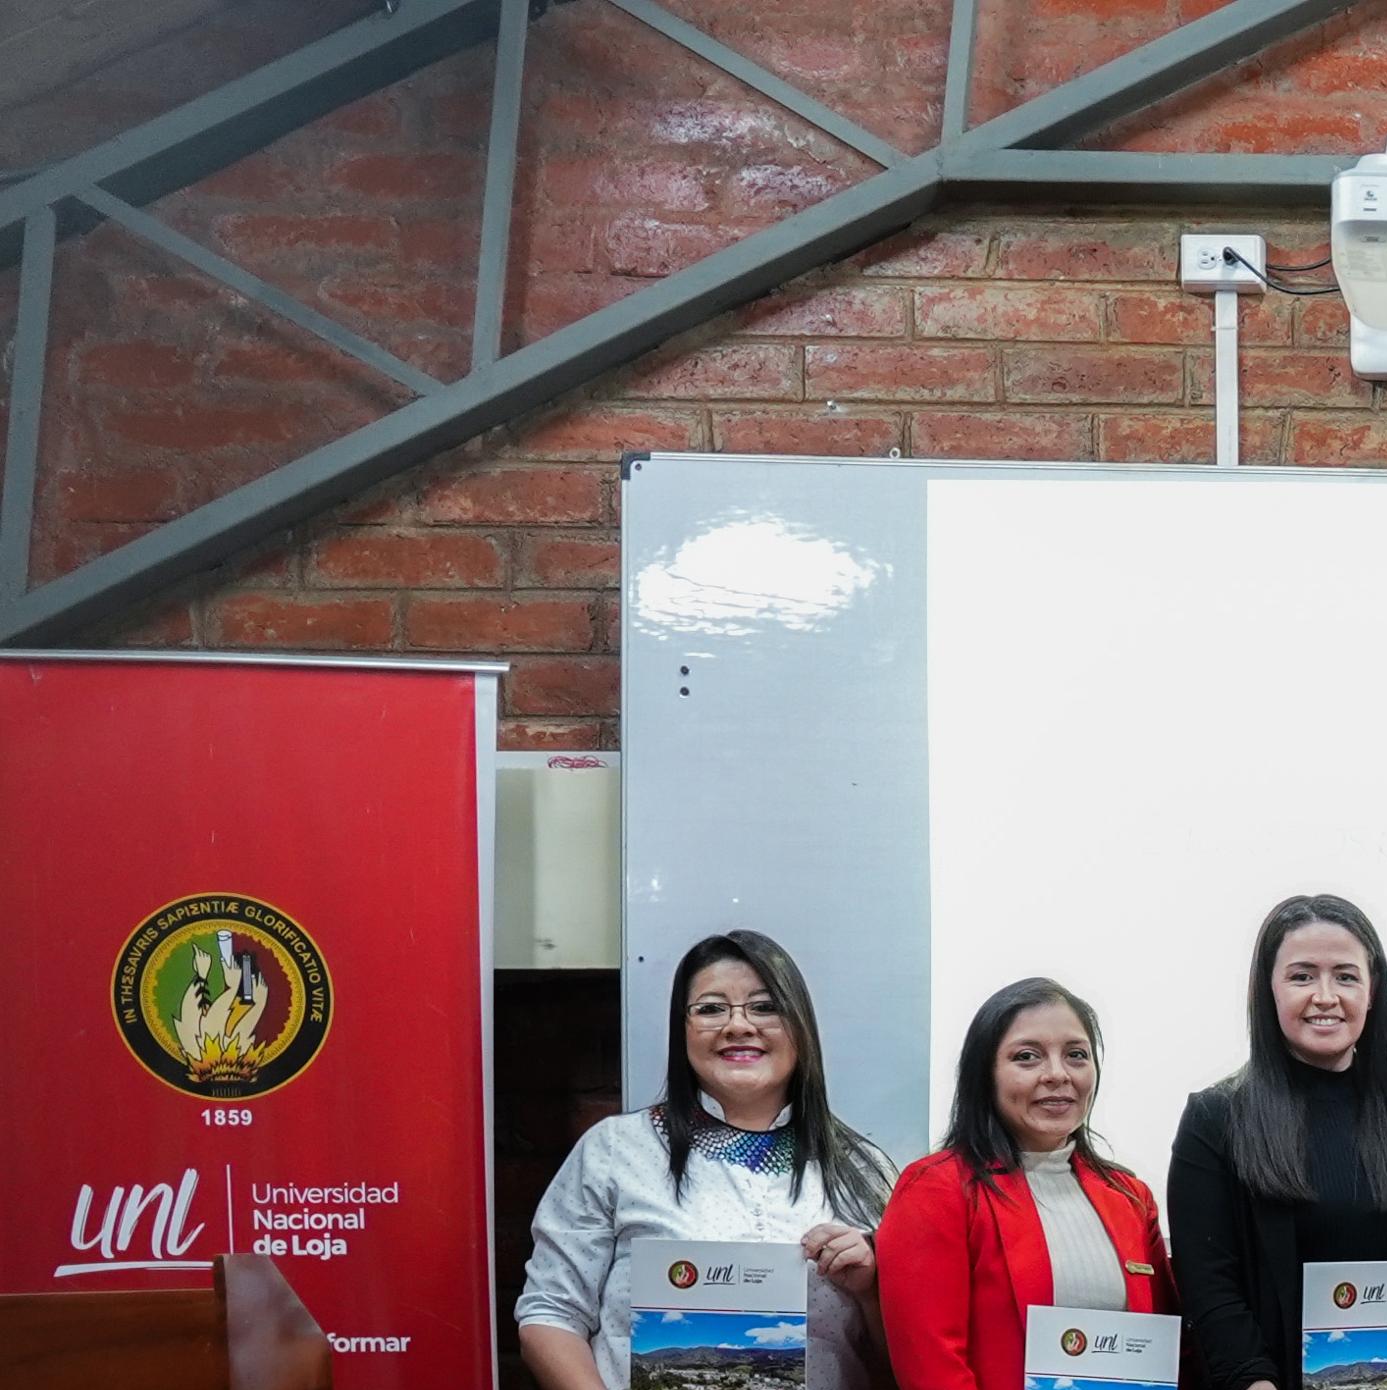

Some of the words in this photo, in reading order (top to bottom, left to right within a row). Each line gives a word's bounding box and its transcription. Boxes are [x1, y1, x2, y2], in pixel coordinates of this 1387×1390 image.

[124, 1009, 138, 1024] IN
[244, 905, 322, 984] GLORIFICATIO
[201, 1109, 253, 1126] 1859
[252, 1182, 399, 1204] Universidad
[70, 1168, 205, 1259] unl
[253, 1208, 366, 1230] Nacional
[253, 1235, 288, 1255] de
[292, 1234, 347, 1260] Loja
[326, 1332, 411, 1353] formar
